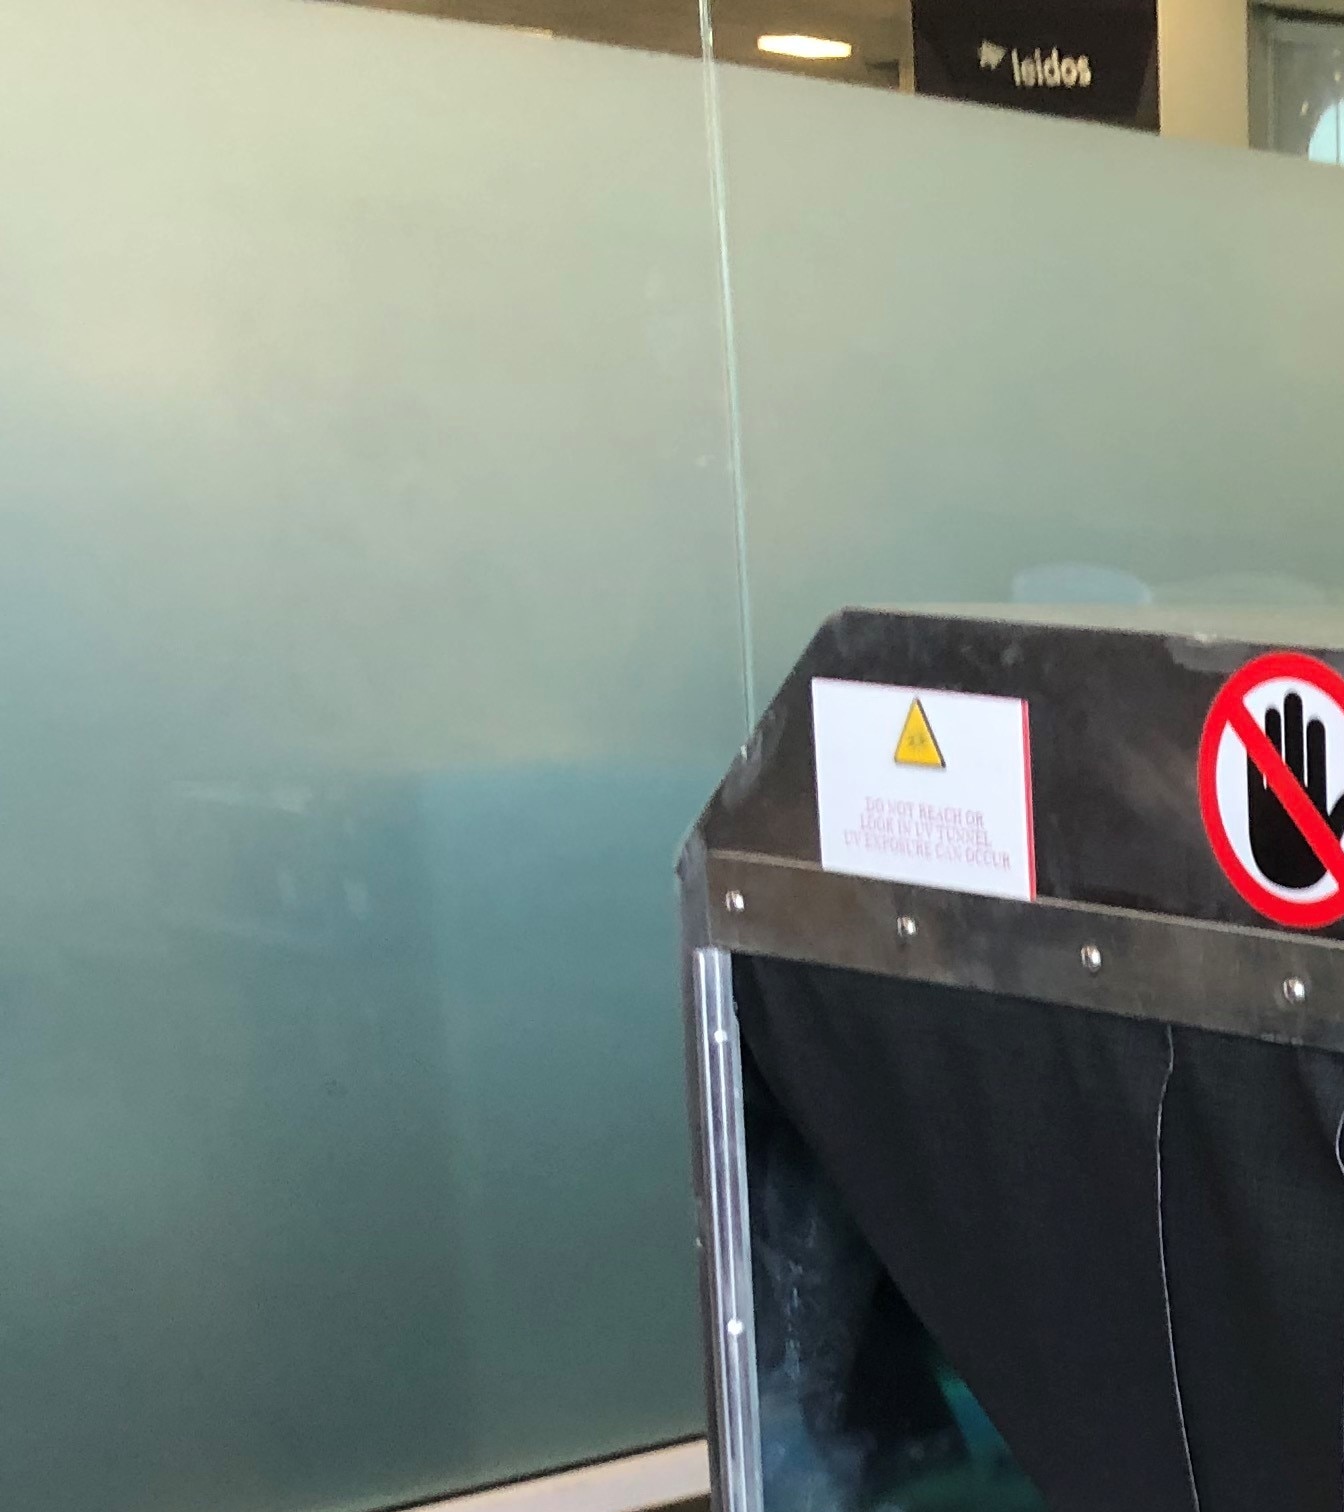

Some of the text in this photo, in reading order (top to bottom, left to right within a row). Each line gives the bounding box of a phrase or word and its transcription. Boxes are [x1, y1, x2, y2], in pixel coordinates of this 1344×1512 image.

[1011, 46, 1091, 88] leidos
[865, 797, 883, 813] DO
[889, 800, 914, 819] NOT
